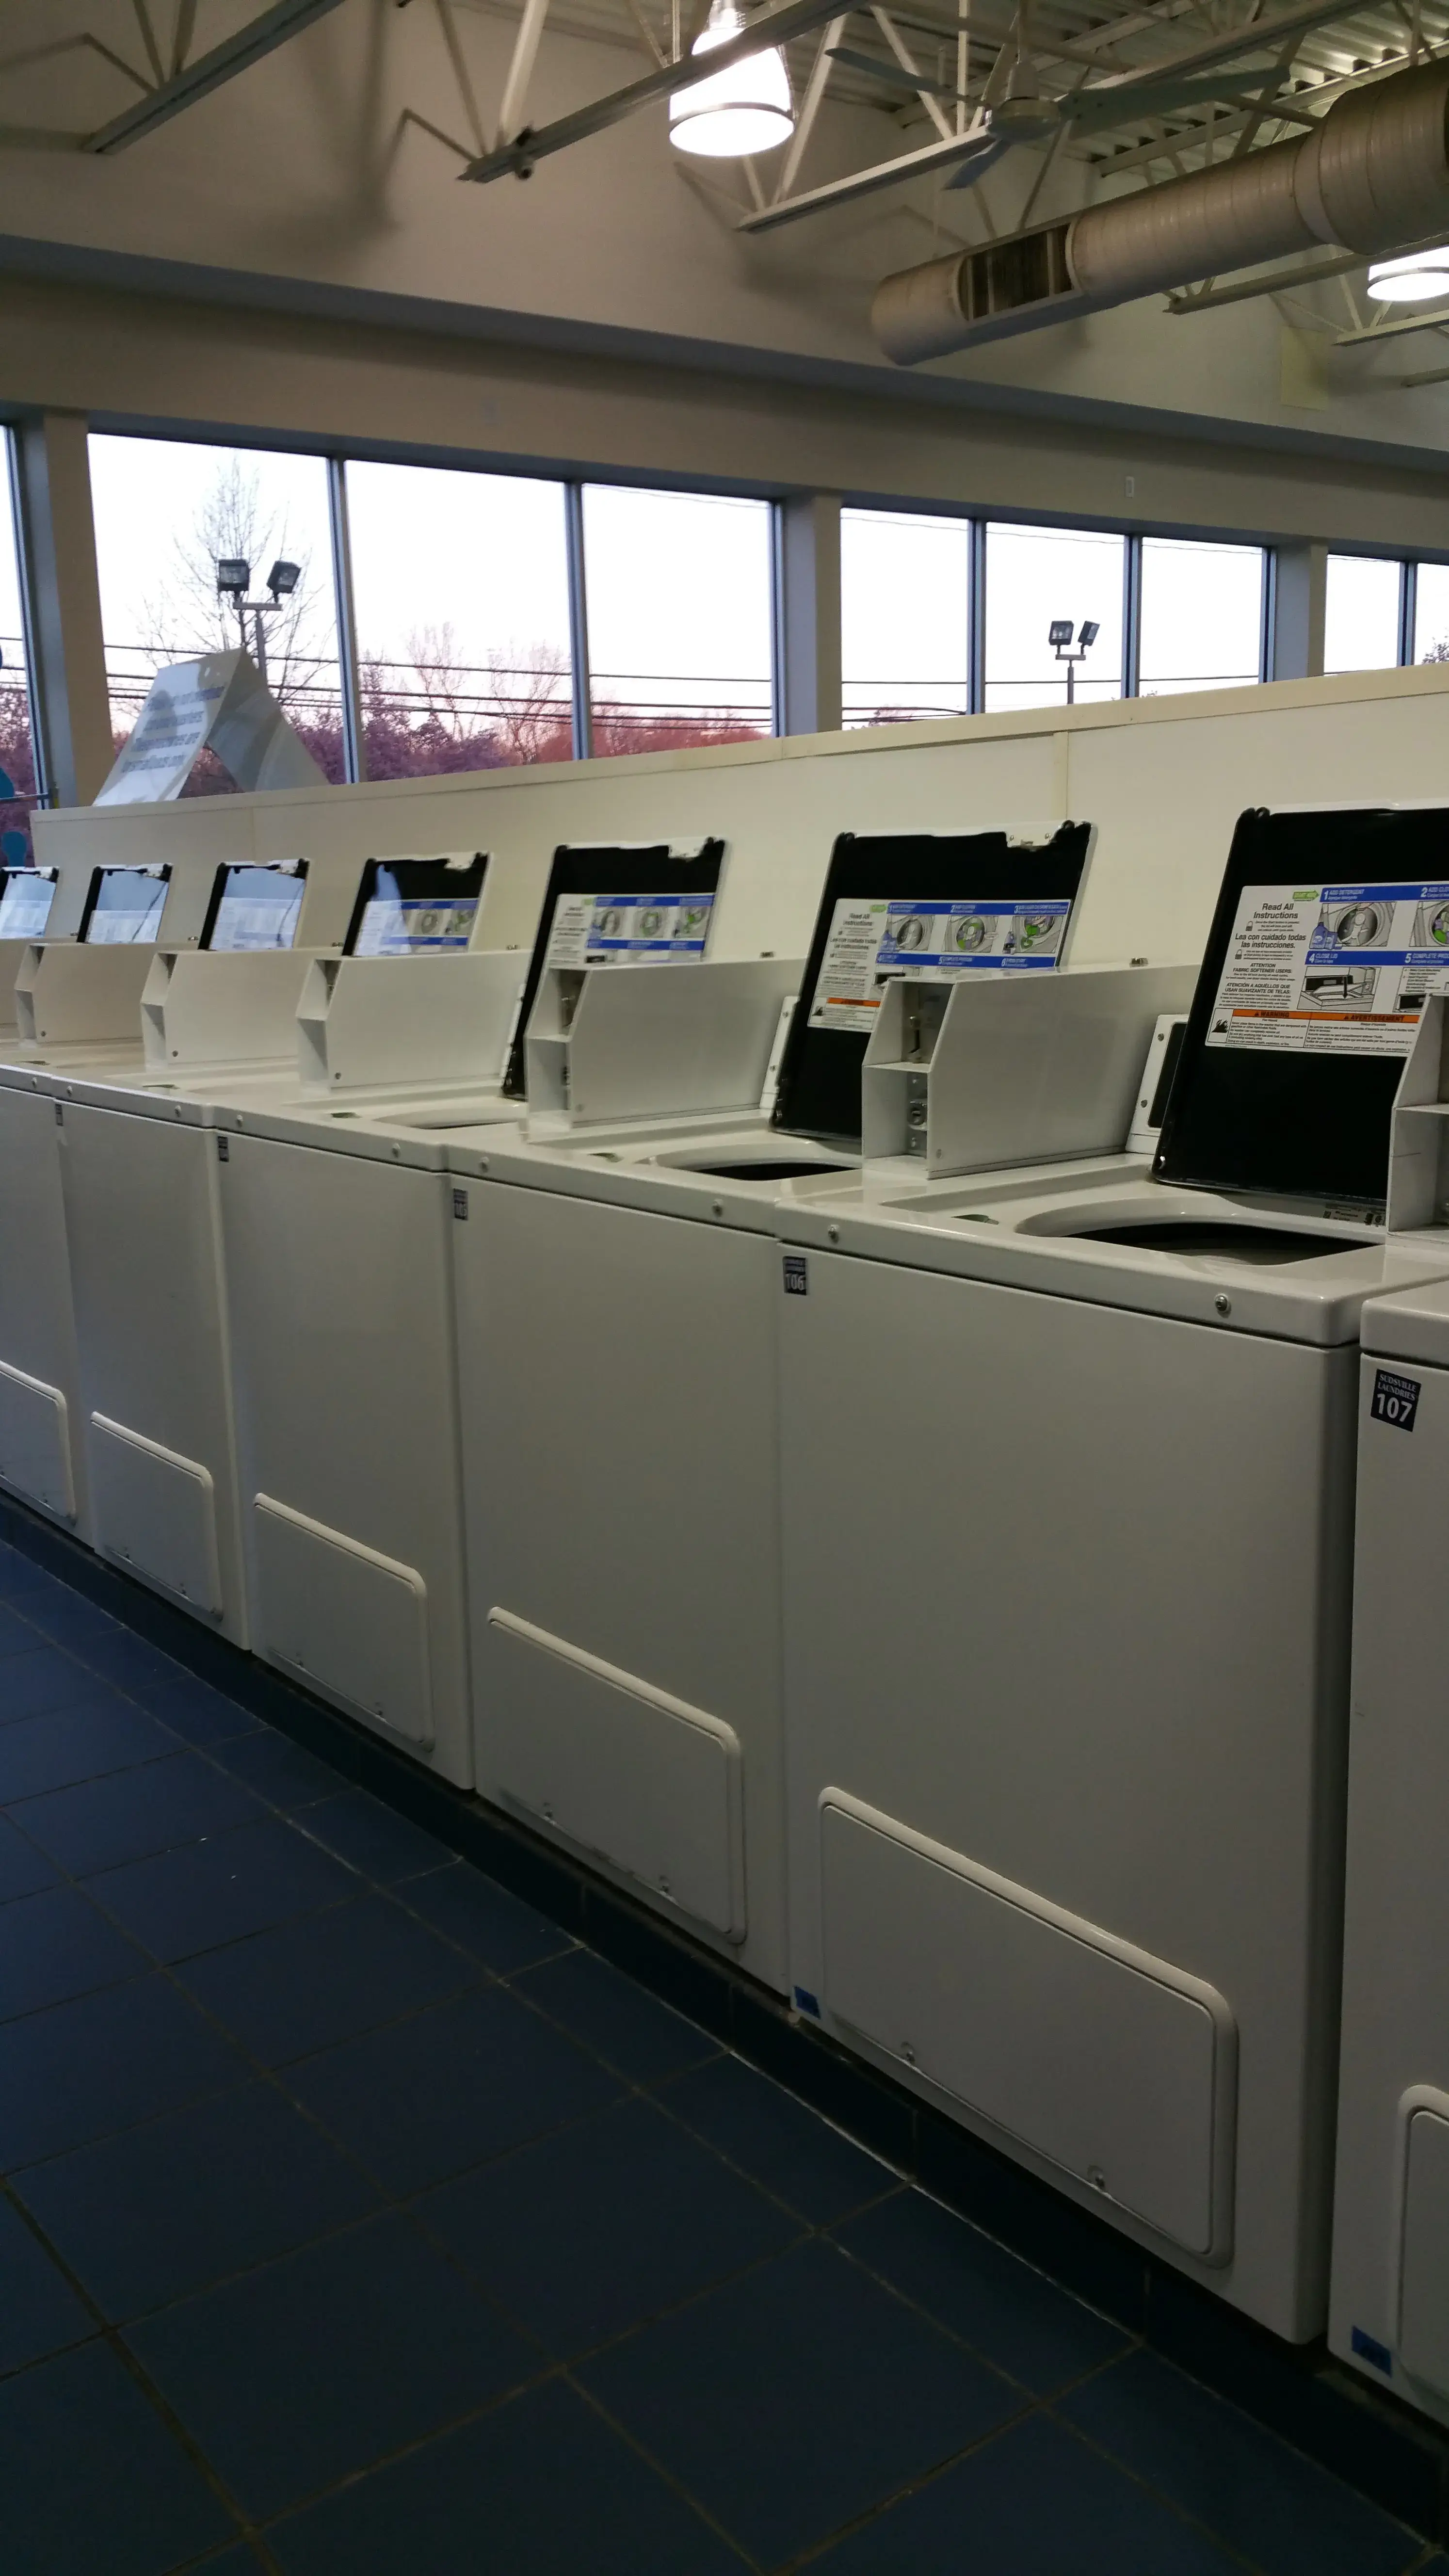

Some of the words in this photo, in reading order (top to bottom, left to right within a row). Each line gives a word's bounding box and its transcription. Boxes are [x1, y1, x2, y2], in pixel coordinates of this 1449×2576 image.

[1324, 890, 1329, 900] 1
[1420, 887, 1428, 897] 2
[1309, 953, 1315, 963] 4
[1405, 953, 1412, 963] 5
[1380, 1373, 1417, 1392] SUDSVILLE
[1378, 1382, 1415, 1401] LAUNDRIES
[1377, 1393, 1412, 1422] 107
